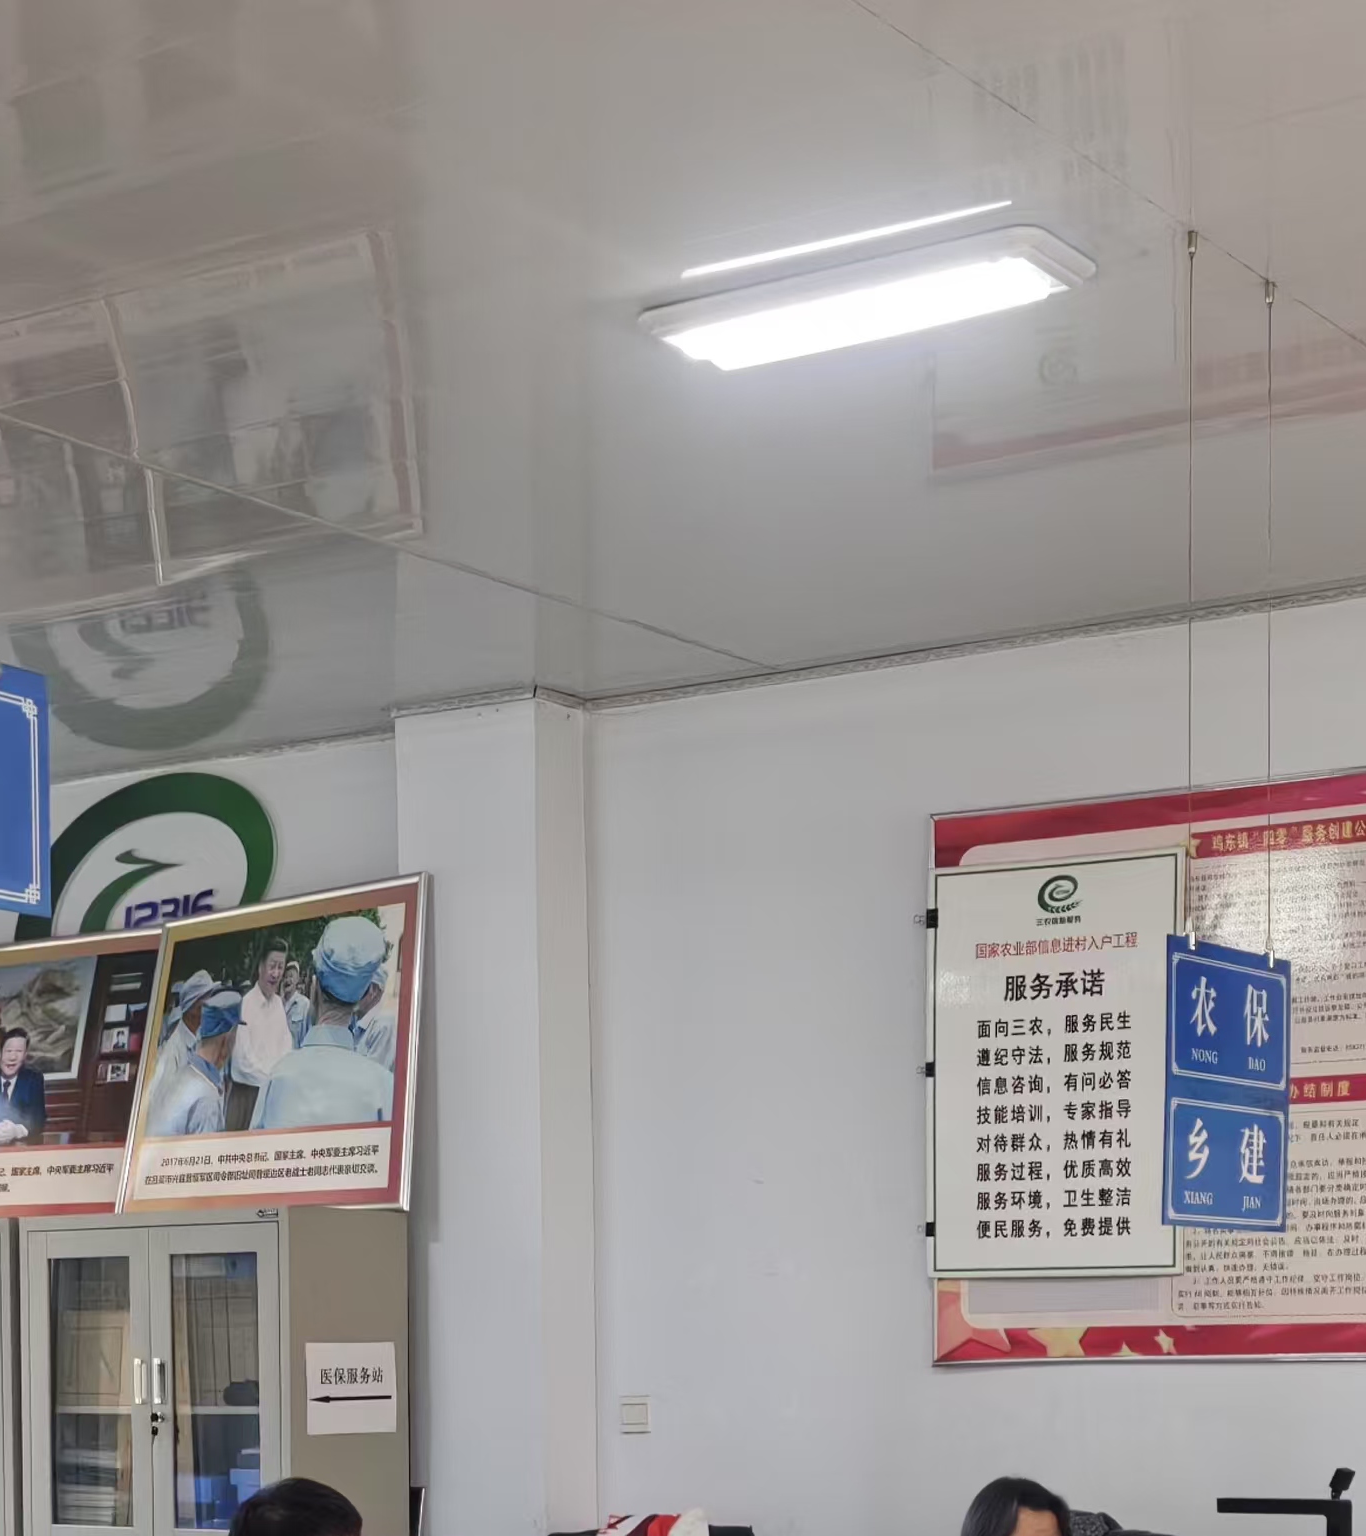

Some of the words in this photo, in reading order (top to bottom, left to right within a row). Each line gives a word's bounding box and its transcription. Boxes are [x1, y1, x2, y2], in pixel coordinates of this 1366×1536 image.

[975, 932, 1138, 959] 国家农业部信息进村入户工程
[1003, 968, 1105, 1001] 服务承诺
[1190, 976, 1269, 1047] 农保
[1191, 1048, 1218, 1064] NONG
[1186, 1117, 1267, 1184] 乡建
[1184, 1190, 1213, 1206] XIANG
[1242, 1196, 1261, 1211] JIAN
[320, 1366, 383, 1385] 医保服务站
